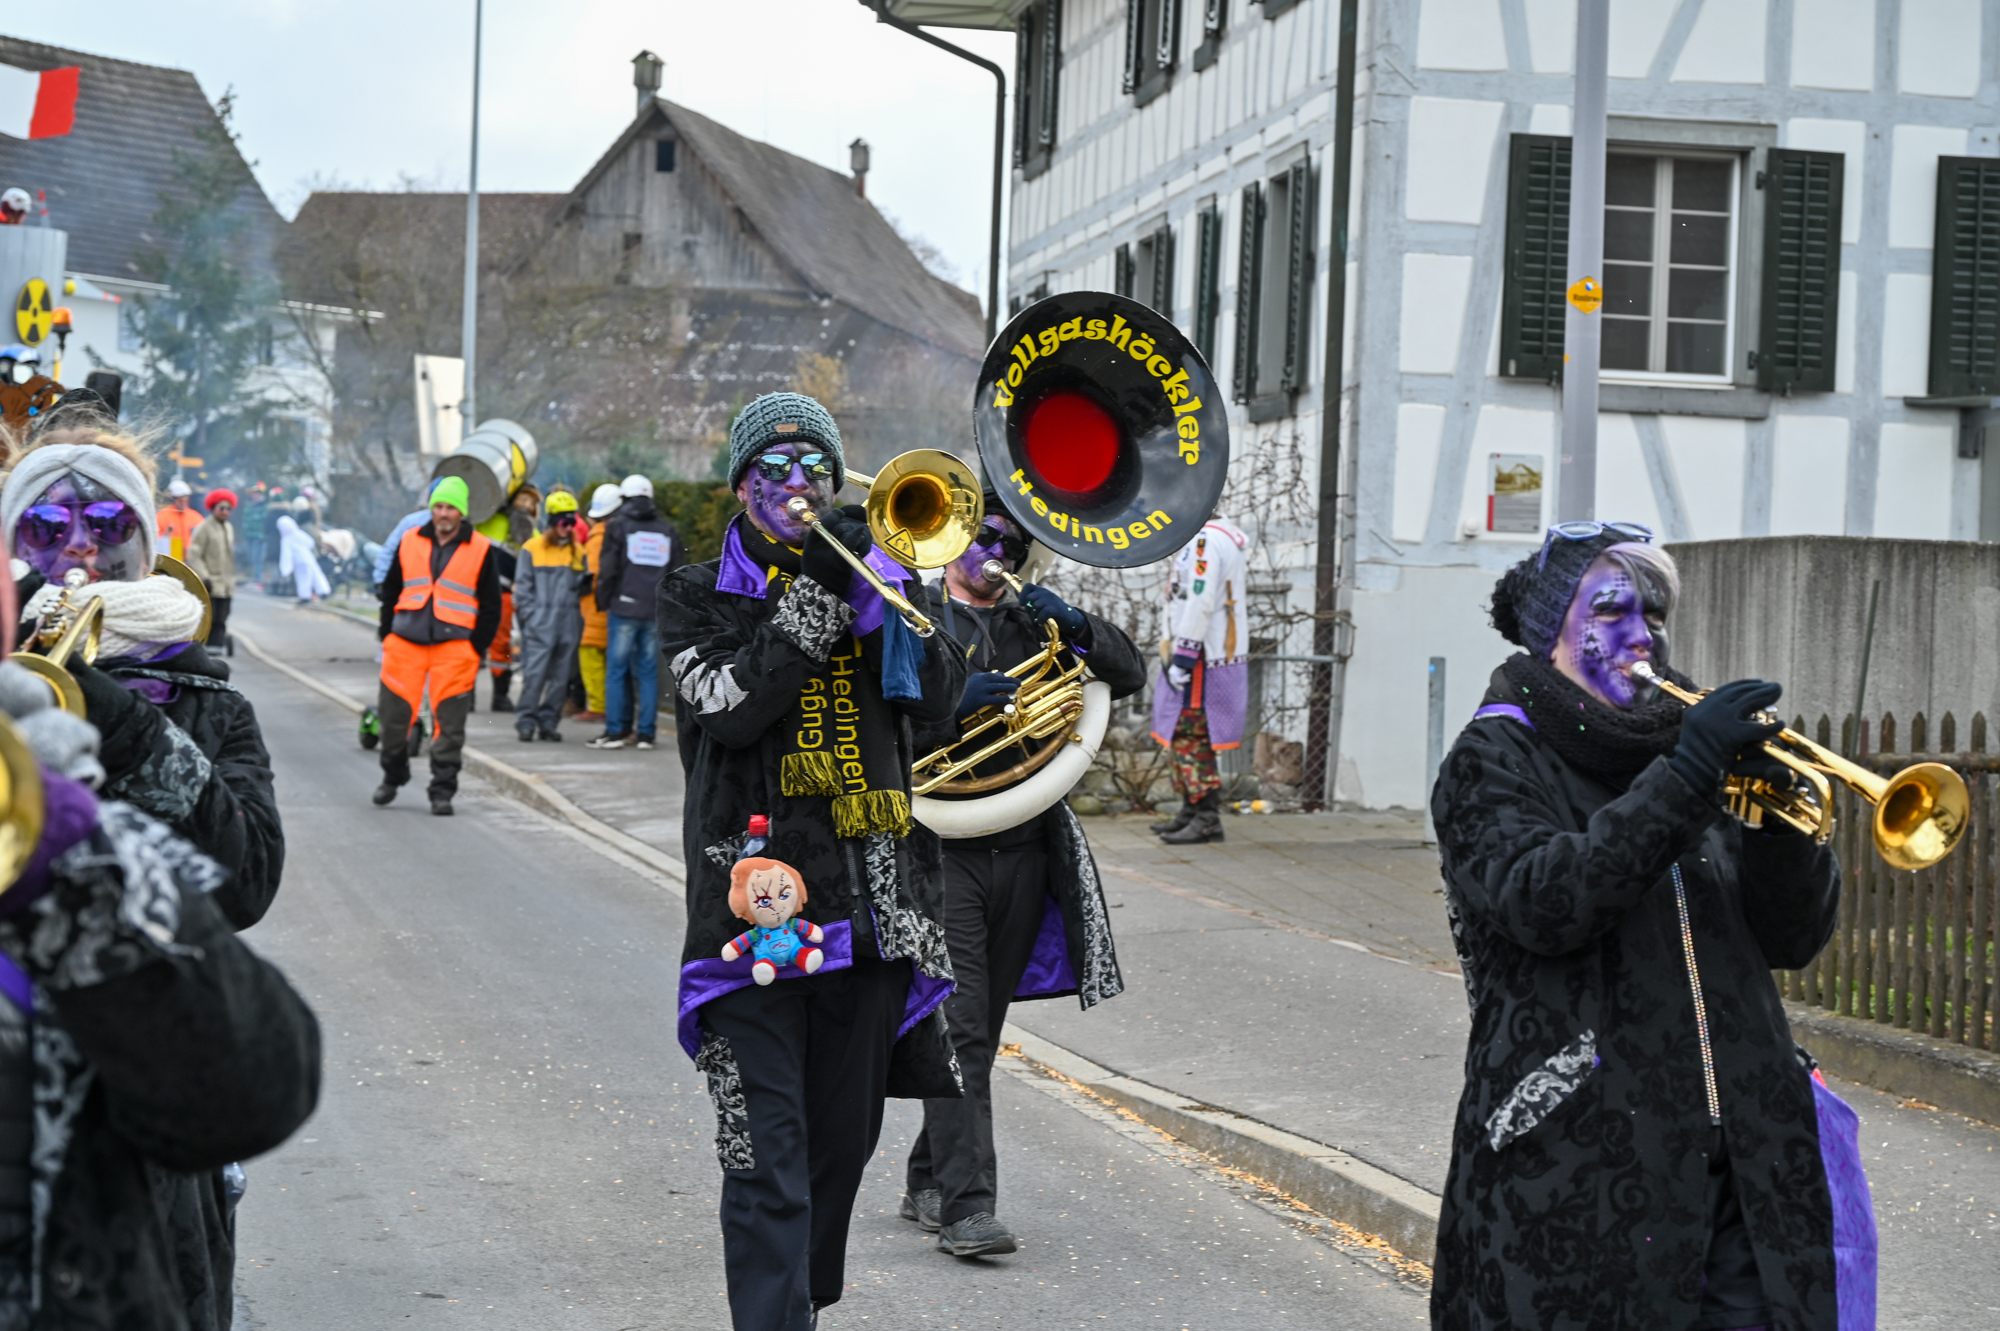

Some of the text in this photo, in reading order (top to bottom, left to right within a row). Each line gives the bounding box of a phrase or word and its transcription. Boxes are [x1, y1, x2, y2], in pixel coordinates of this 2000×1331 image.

[993, 314, 1203, 466] Vollgashöckler
[1009, 468, 1173, 550] Hedingen
[830, 654, 868, 794] Hedingen
